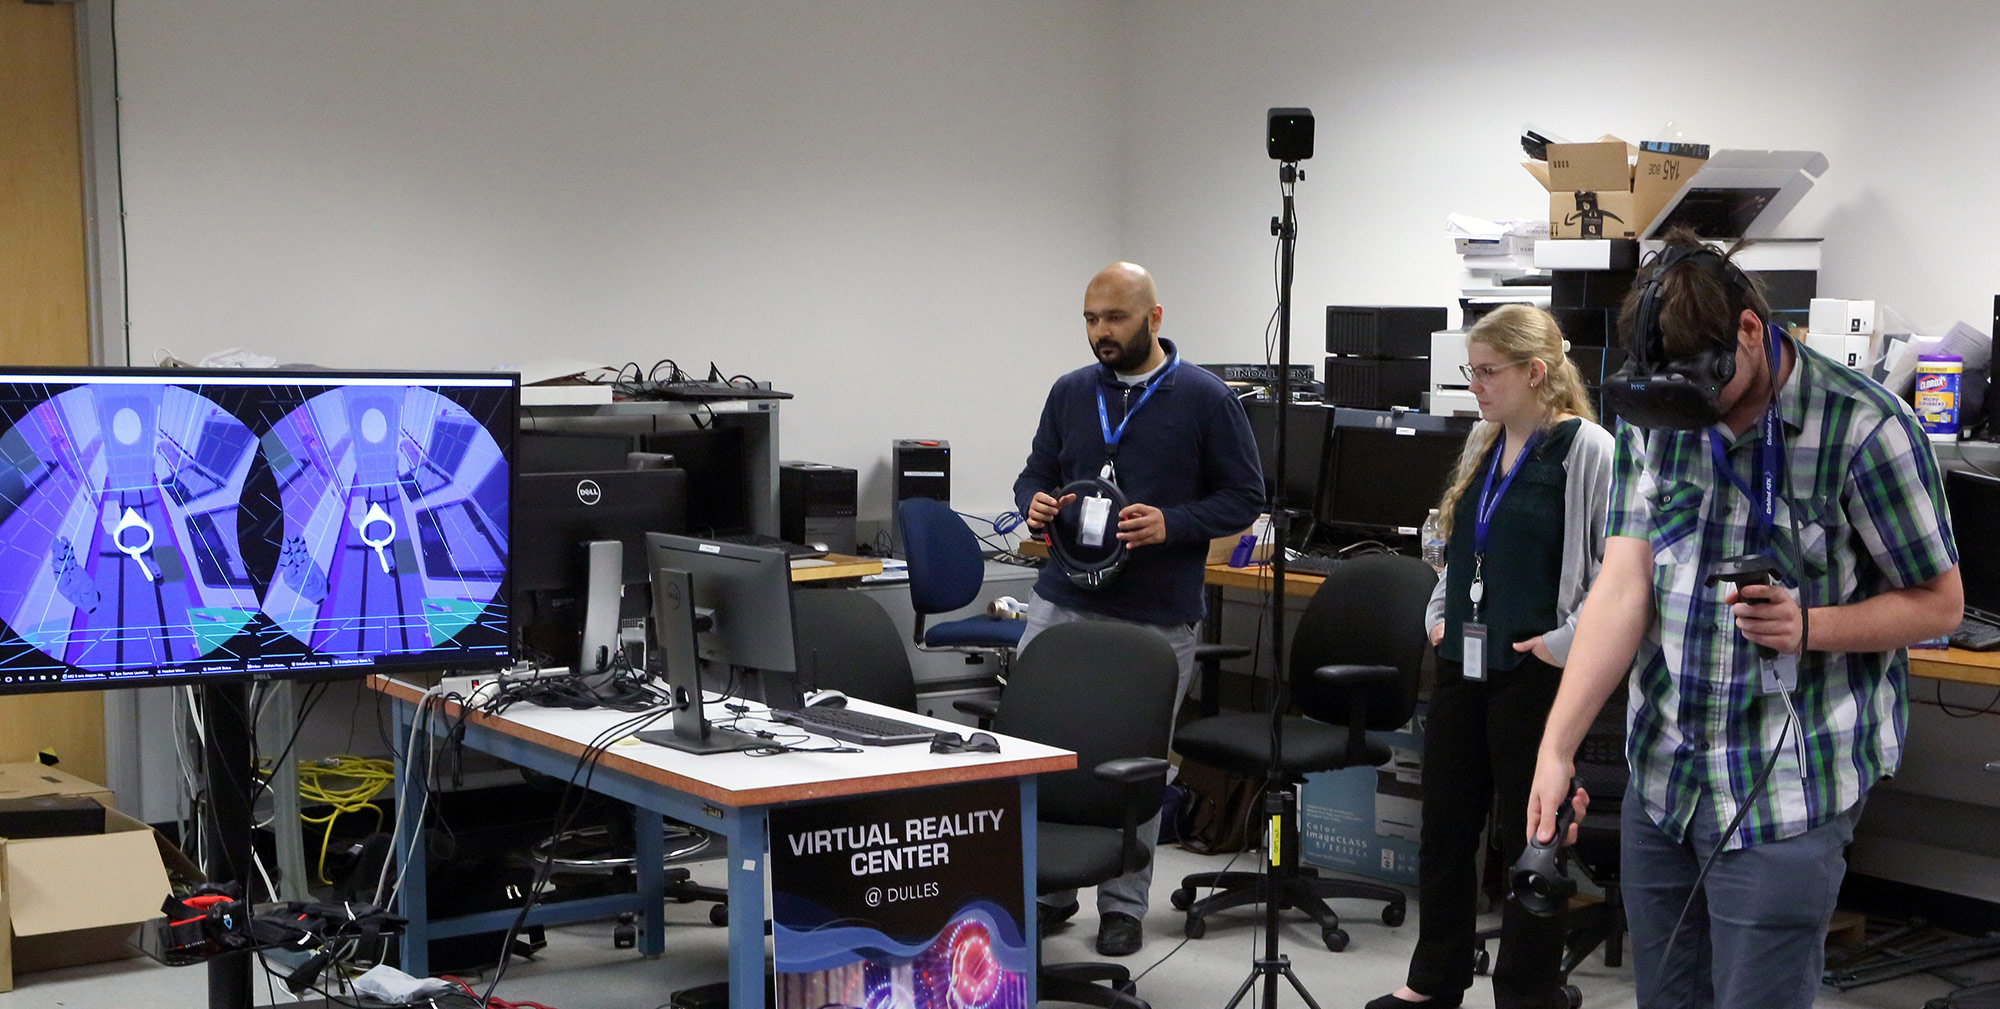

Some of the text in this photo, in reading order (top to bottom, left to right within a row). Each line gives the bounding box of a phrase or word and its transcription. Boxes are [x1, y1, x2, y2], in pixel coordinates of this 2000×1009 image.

[1663, 159, 1681, 181] 1A5
[1224, 367, 1312, 380] KETRONIC
[1919, 376, 1945, 391] CLOROX
[579, 488, 599, 496] DELL
[788, 809, 1004, 856] VIRTUAL REALITY
[1306, 822, 1336, 834] Color
[850, 842, 950, 876] CENTER
[865, 882, 939, 907] @ DULLES
